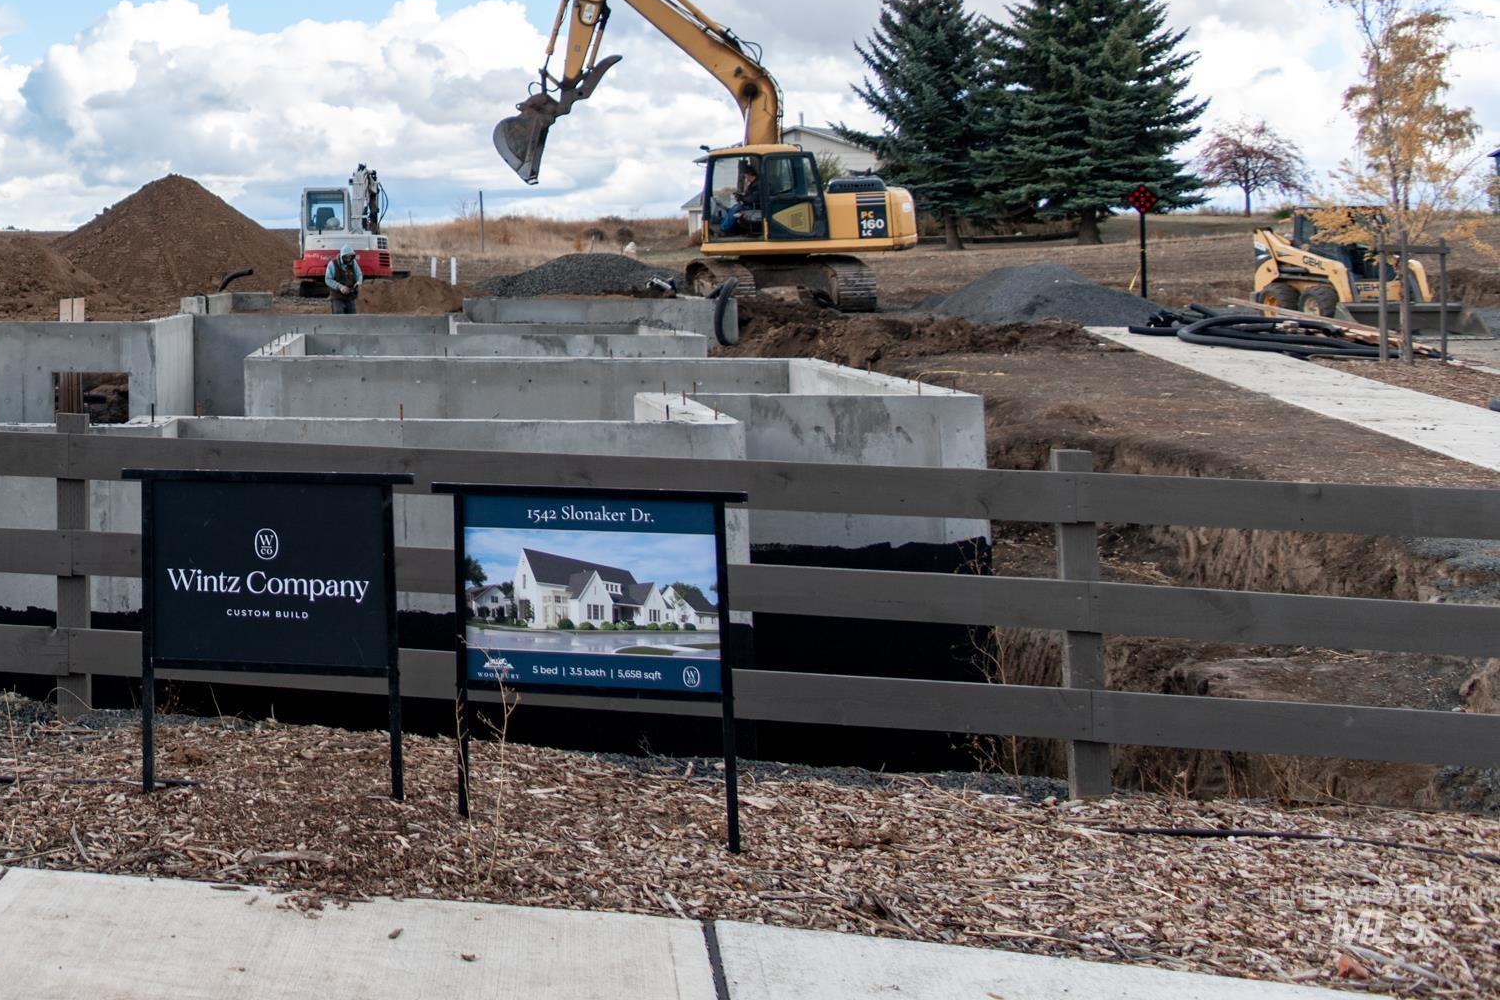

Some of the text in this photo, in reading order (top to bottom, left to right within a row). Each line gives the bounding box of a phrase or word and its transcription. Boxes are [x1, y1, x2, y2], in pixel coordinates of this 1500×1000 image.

[861, 211, 874, 219] PC
[861, 219, 884, 229] 160
[1302, 255, 1325, 271] GEHL
[527, 505, 655, 523] 1542 Slonaker Dr.
[259, 534, 274, 546] W
[167, 568, 369, 603] Wintz Company
[226, 609, 309, 619] CUSTOM BUILD
[532, 665, 539, 674] 5
[540, 666, 558, 675] bed
[569, 667, 583, 676] 3.5
[584, 667, 606, 677] bath
[617, 669, 642, 679] 5,658
[643, 670, 662, 680] sqft
